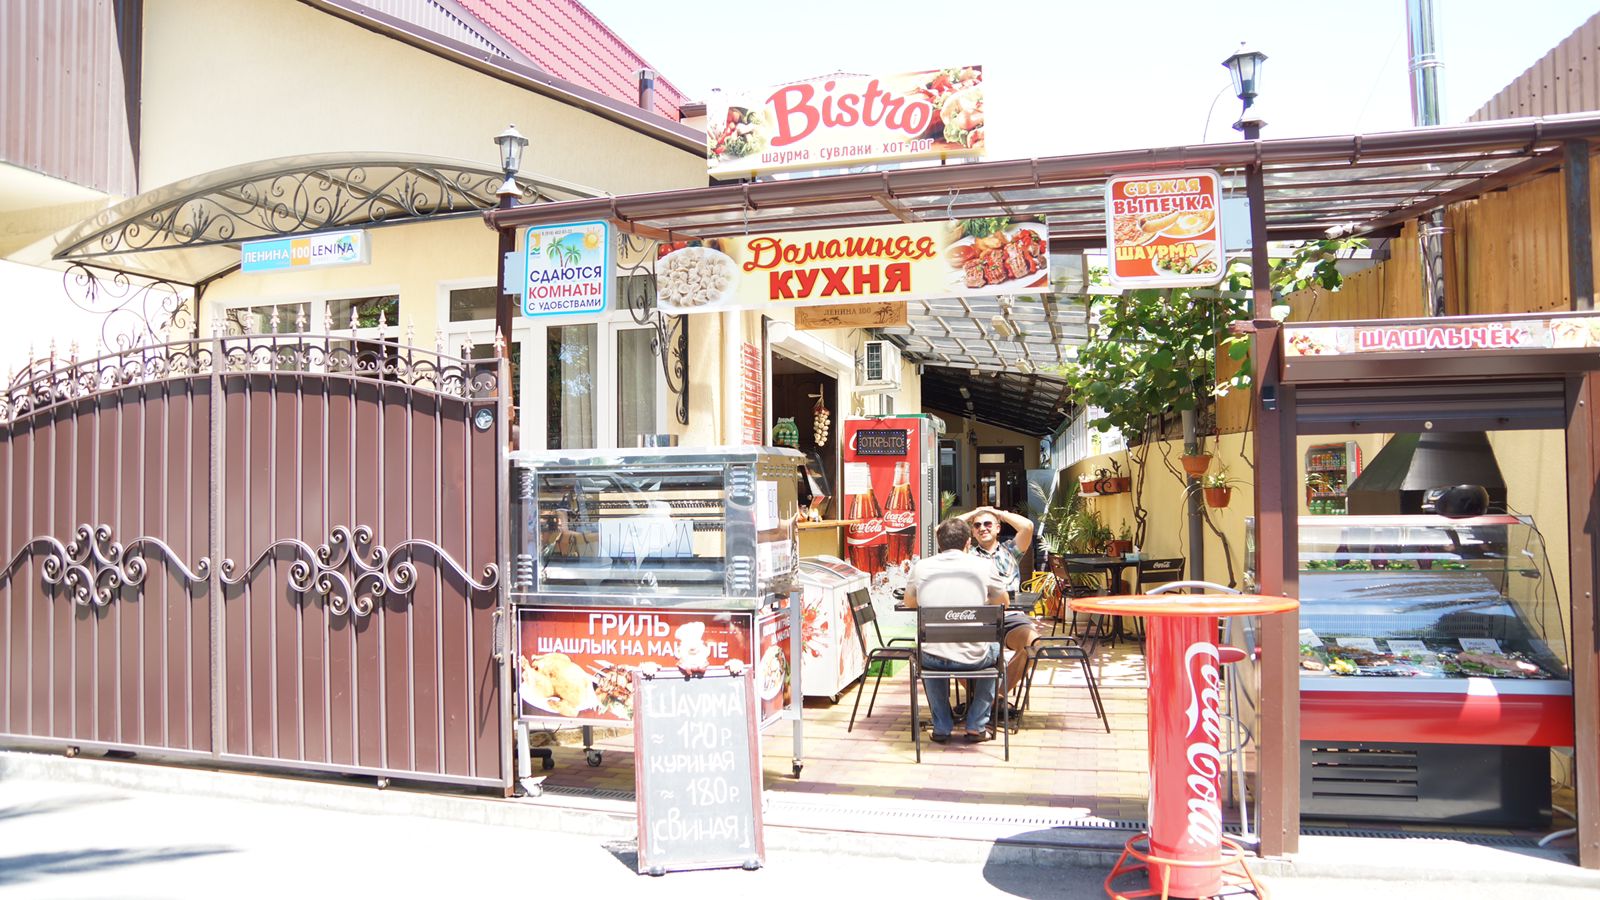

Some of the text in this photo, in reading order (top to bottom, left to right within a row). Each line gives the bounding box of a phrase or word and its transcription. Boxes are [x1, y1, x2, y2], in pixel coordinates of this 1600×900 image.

[765, 79, 930, 147] Bistro
[762, 139, 933, 163] шаурма сувлаки хот-дог
[1124, 178, 1201, 197] СВЕЖАЯ
[1114, 194, 1214, 215] ВЫПЕЧКА
[244, 249, 289, 263] ЛЕНИНА
[292, 247, 310, 259] 100
[312, 243, 354, 257] LENINA
[743, 235, 935, 271] Домашняя
[1115, 243, 1198, 261] ШАУРМА
[530, 266, 602, 284] СДАЮТСЯ
[769, 262, 911, 300] КУХНЯ
[529, 282, 602, 299] КОМНАТЫ
[539, 299, 601, 311] УДОБСТВАМИ
[1361, 322, 1520, 348] ШАШЛЫЧЁК
[861, 436, 903, 448] ОТКРЫТО
[588, 613, 671, 638] ГРИЛЬ
[537, 637, 617, 656] ШАШЛЫК
[620, 640, 645, 656] НА
[650, 750, 736, 774] КУРИНАЯ
[655, 807, 738, 841] СВИНАЯ
